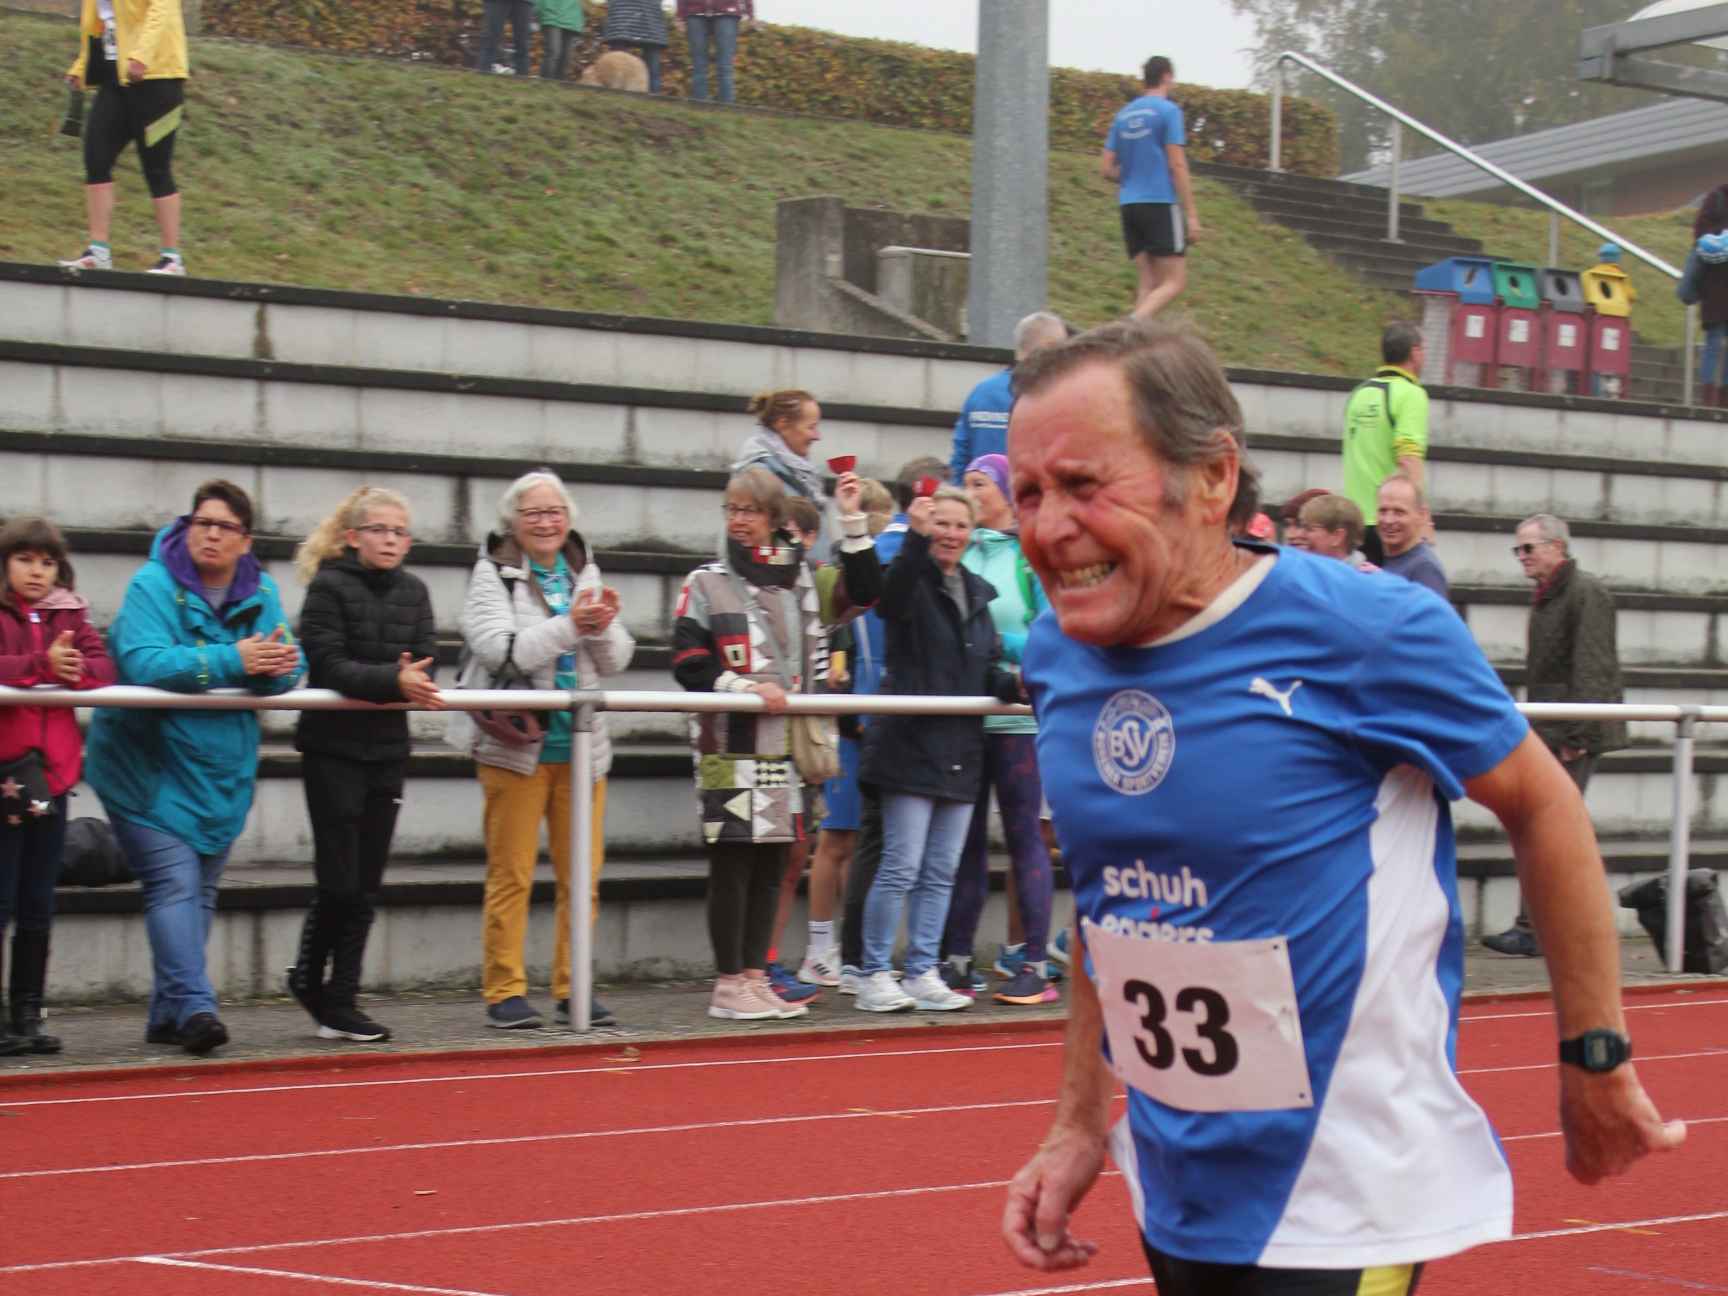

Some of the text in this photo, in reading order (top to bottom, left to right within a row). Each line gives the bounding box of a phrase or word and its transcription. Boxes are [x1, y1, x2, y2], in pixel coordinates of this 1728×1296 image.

[1109, 720, 1154, 768] BSV
[1102, 858, 1208, 908] schuh
[1123, 978, 1240, 1078] 33
